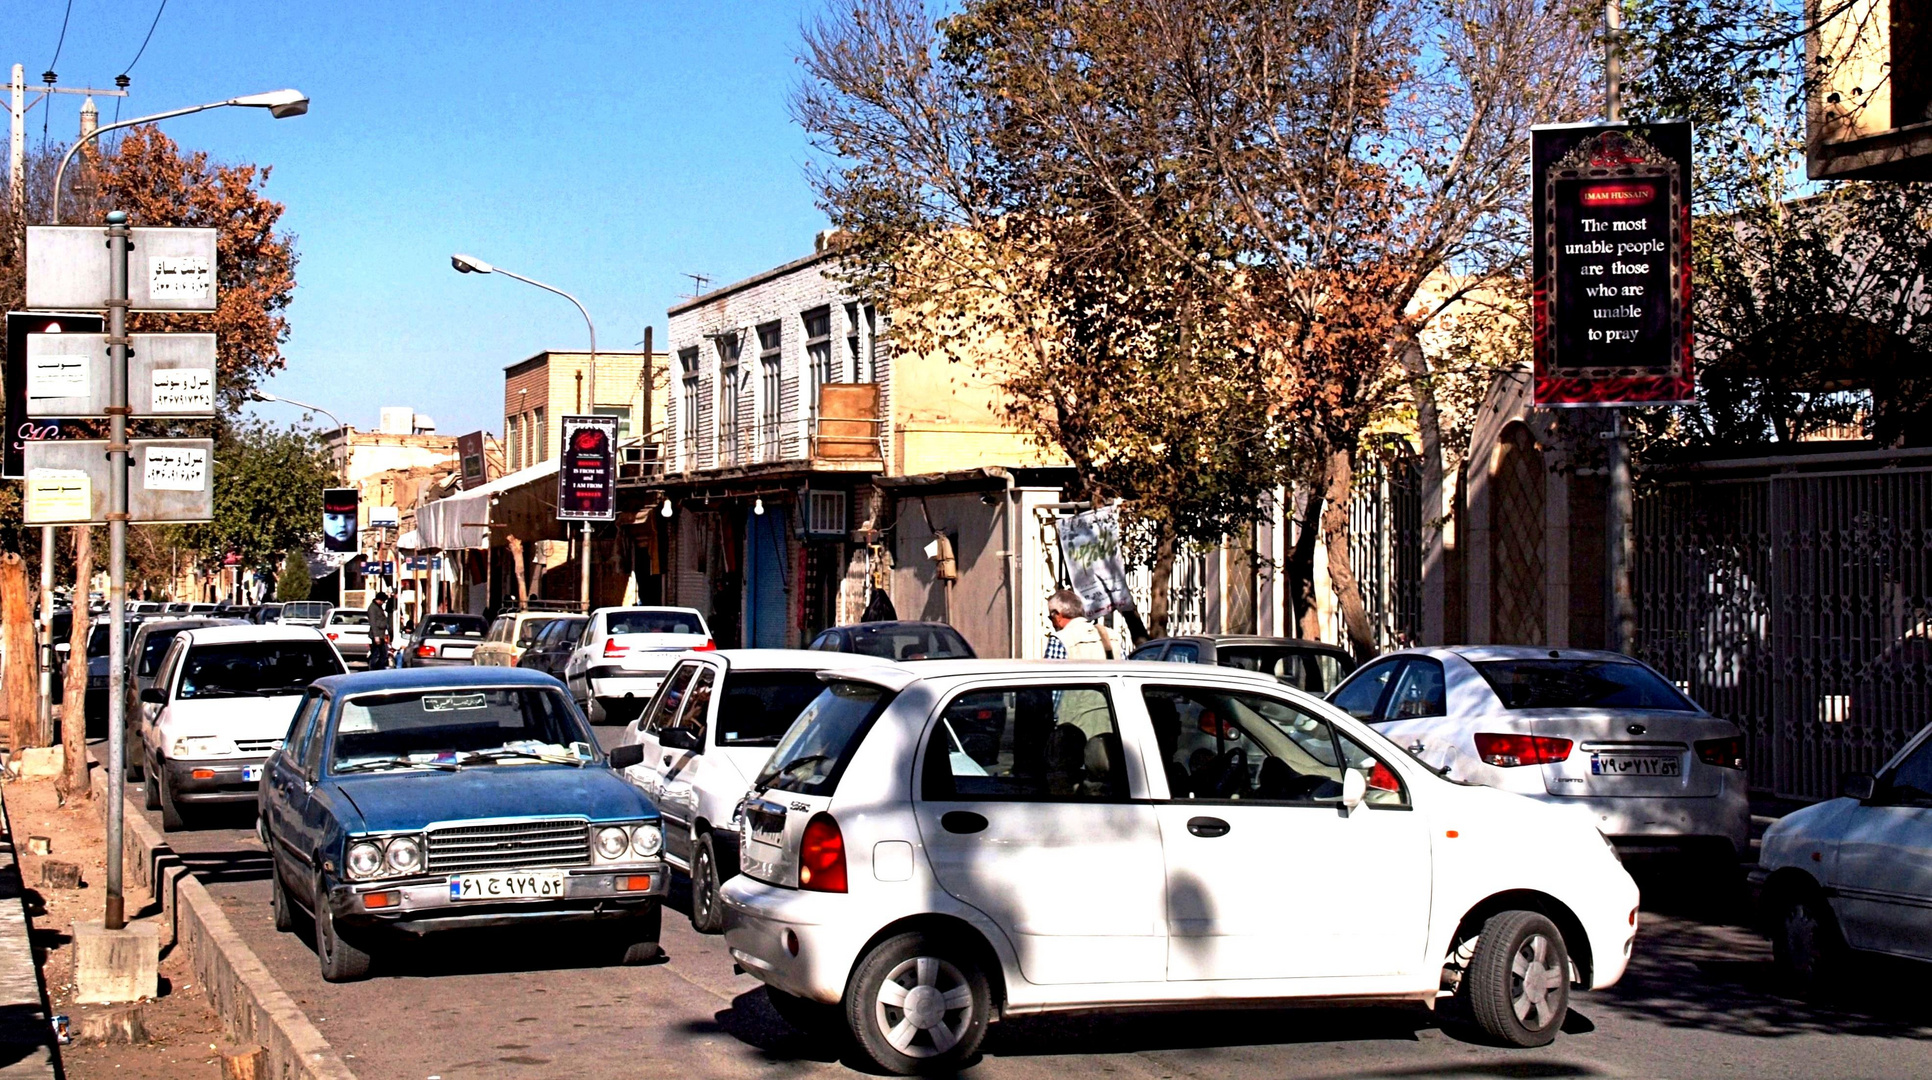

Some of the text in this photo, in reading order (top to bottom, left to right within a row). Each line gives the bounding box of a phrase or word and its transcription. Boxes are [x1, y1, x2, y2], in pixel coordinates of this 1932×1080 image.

[1584, 191, 1649, 200] IMAM HUSSAIN
[1582, 219, 1647, 232] The most
[1565, 239, 1665, 256] unable people
[1580, 261, 1649, 276] are those
[1586, 284, 1644, 297] who are
[1593, 306, 1642, 318] unable
[1588, 328, 1639, 343] to pray
[184, 380, 187, 390] و
[177, 457, 181, 467] و
